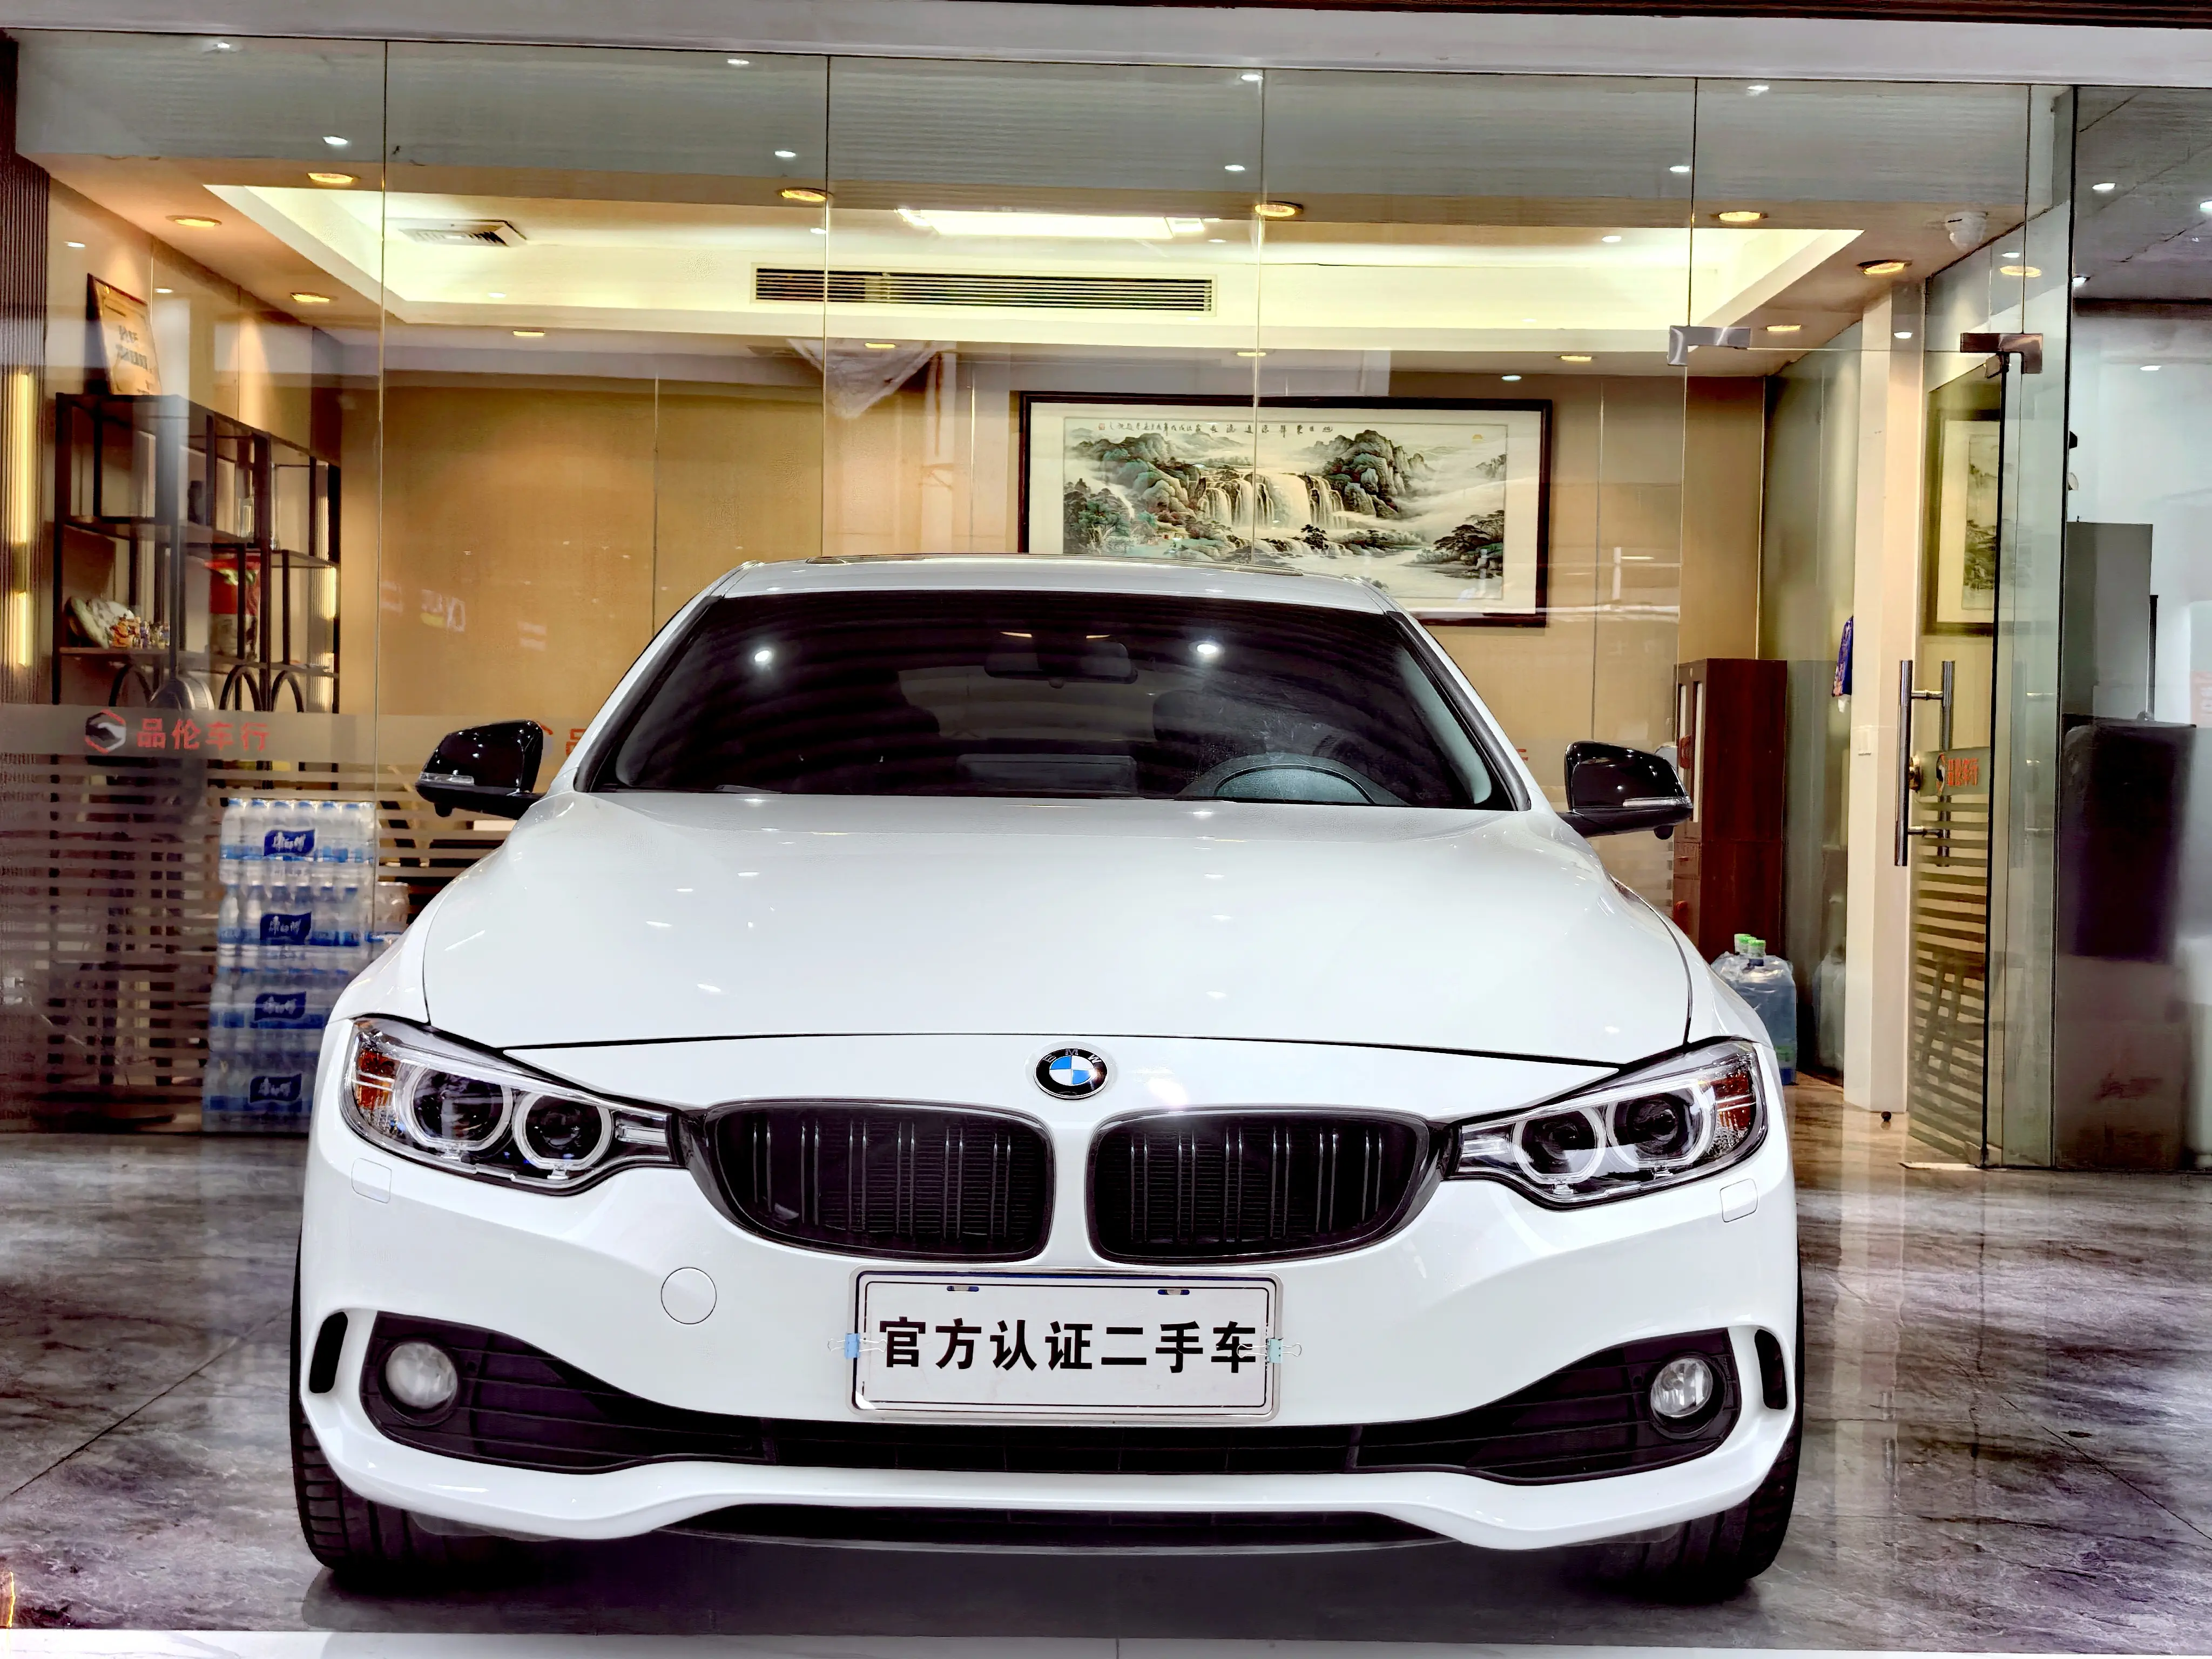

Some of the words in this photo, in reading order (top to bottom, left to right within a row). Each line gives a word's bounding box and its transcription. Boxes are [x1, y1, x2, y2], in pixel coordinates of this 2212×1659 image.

[137, 718, 270, 751] 品伦车行
[1043, 1048, 1102, 1064] BMW
[879, 1316, 1256, 1374] 官方认证二手车
